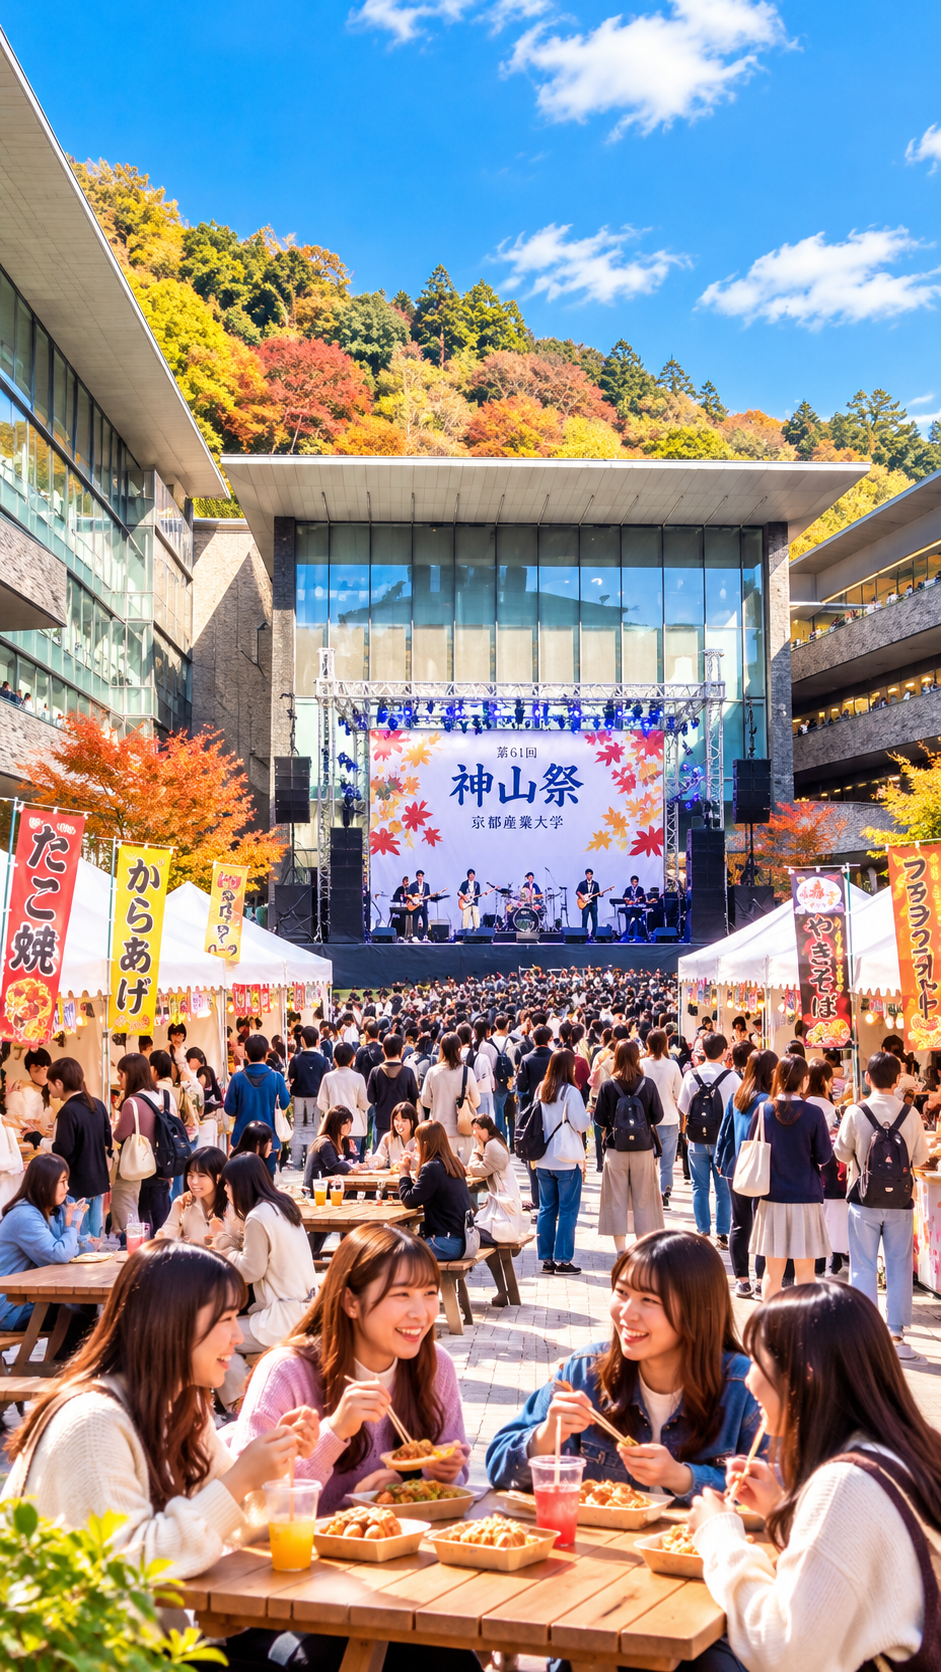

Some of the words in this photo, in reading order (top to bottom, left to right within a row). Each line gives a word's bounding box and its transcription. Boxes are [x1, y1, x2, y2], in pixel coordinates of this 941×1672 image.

[450, 763, 584, 807] 神山祭
[471, 815, 564, 830] 京都産業大学
[116, 857, 161, 1015] からあげ
[806, 914, 838, 1019] やきそば
